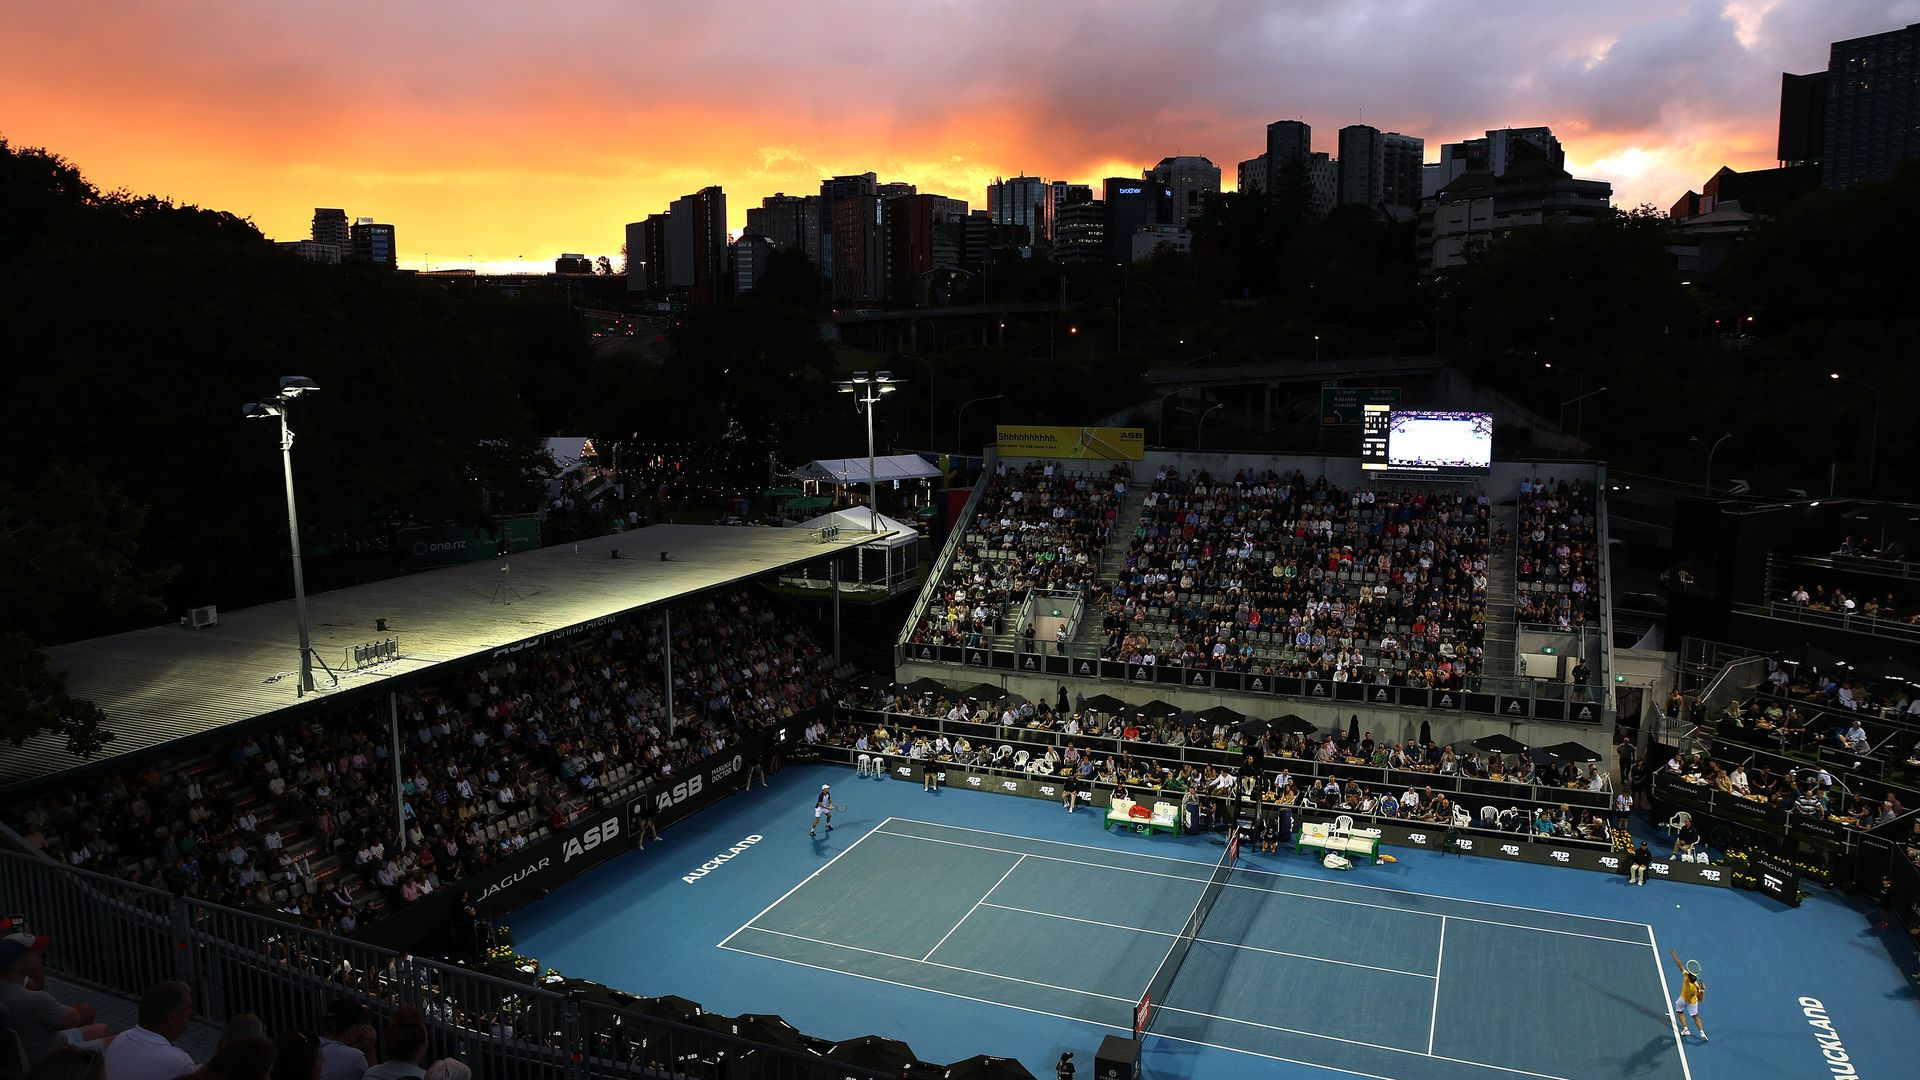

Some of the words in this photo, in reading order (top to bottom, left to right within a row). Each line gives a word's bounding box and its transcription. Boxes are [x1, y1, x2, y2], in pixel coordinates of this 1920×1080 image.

[429, 540, 467, 551] one.nz
[656, 774, 703, 813] ASB
[711, 767, 732, 783] DOCTOR
[562, 816, 620, 863] ASB
[681, 833, 764, 885] AUCKLAND
[477, 856, 550, 902] JAGUAR
[1757, 860, 1793, 878] JAGUAR
